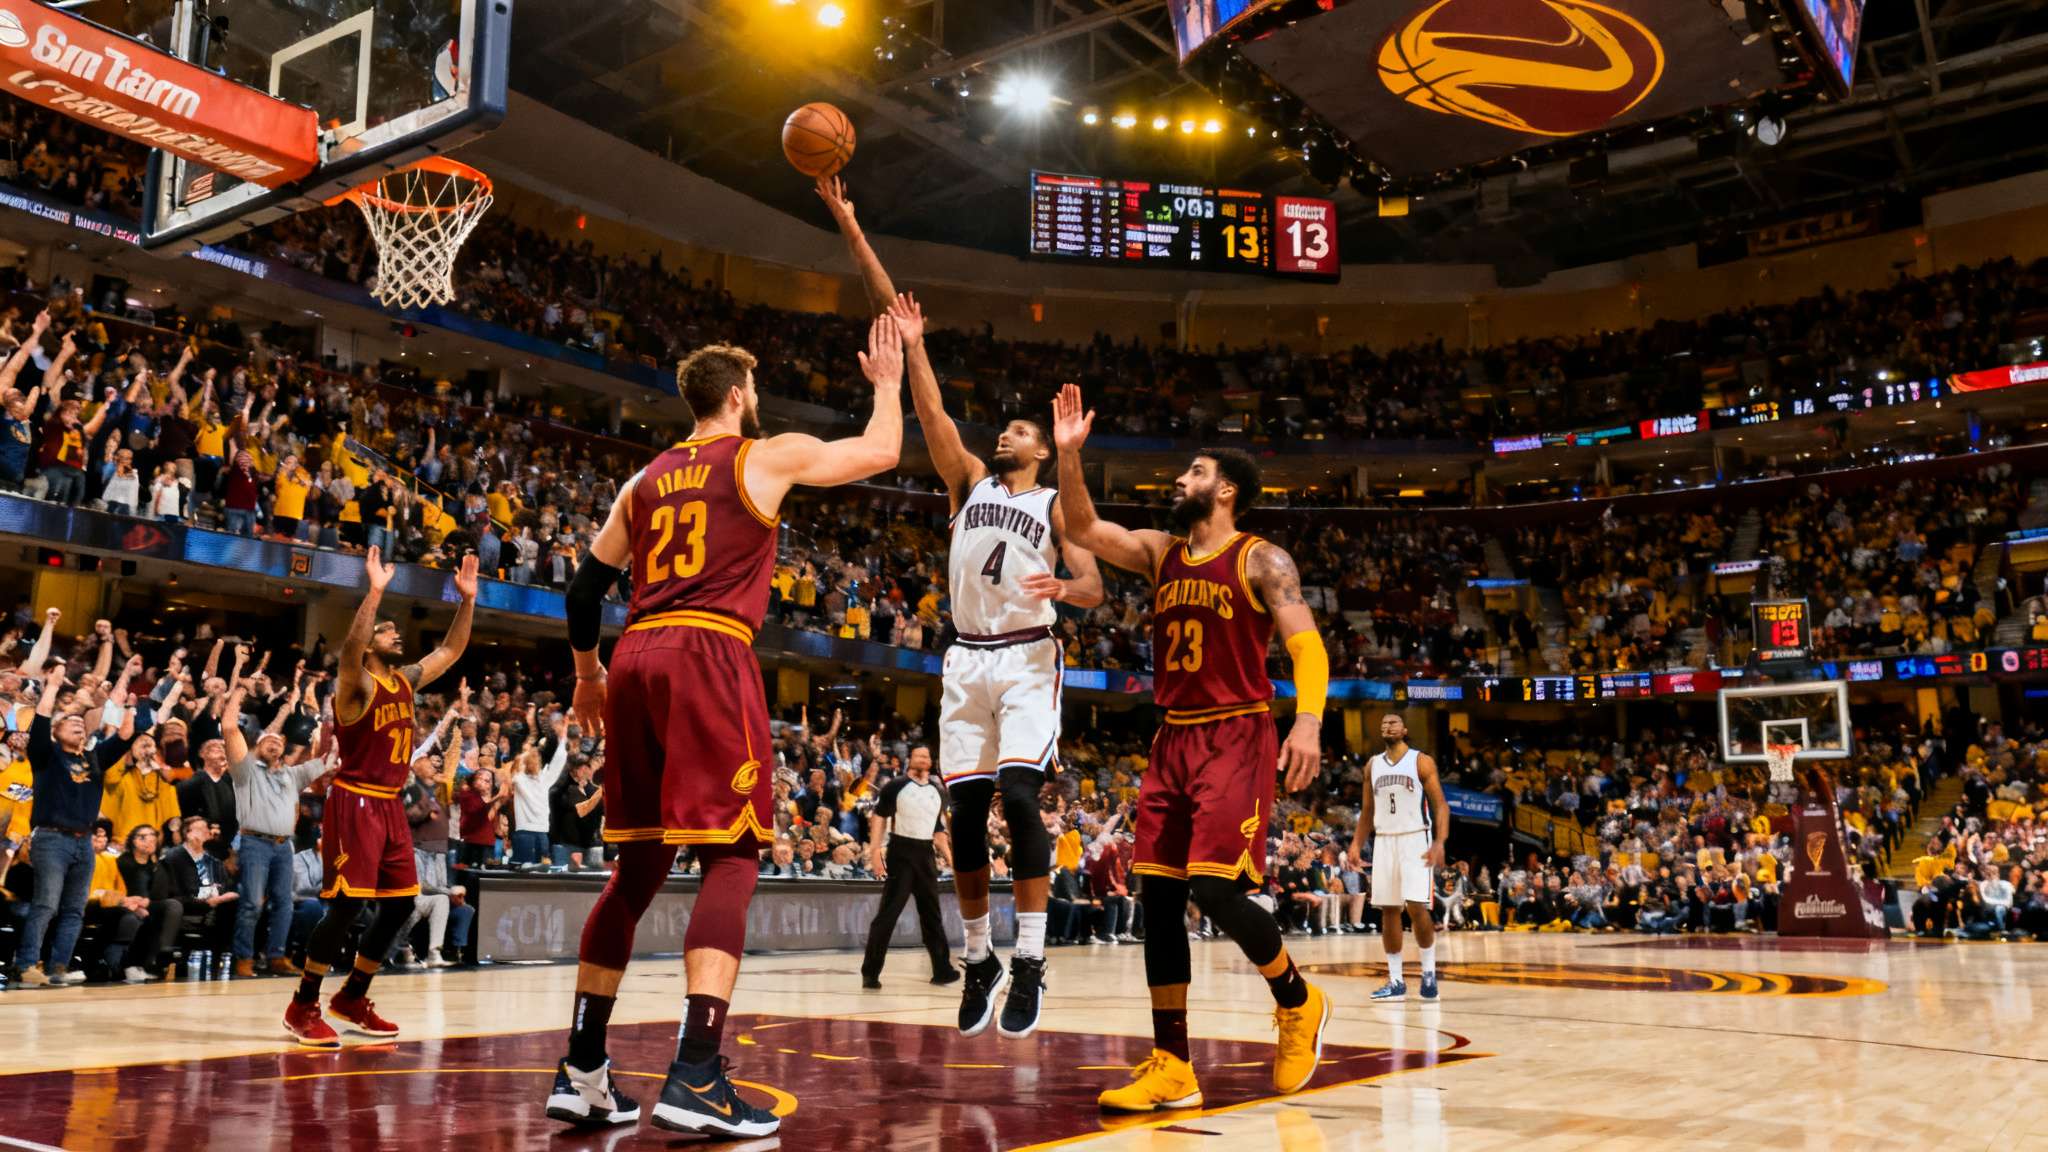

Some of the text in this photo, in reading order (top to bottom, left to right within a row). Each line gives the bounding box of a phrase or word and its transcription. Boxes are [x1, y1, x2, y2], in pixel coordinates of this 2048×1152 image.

[1222, 224, 1260, 259] 13
[1286, 220, 1329, 259] 13
[647, 500, 707, 584] 23
[981, 541, 1007, 585] 4
[1165, 619, 1203, 672] 23
